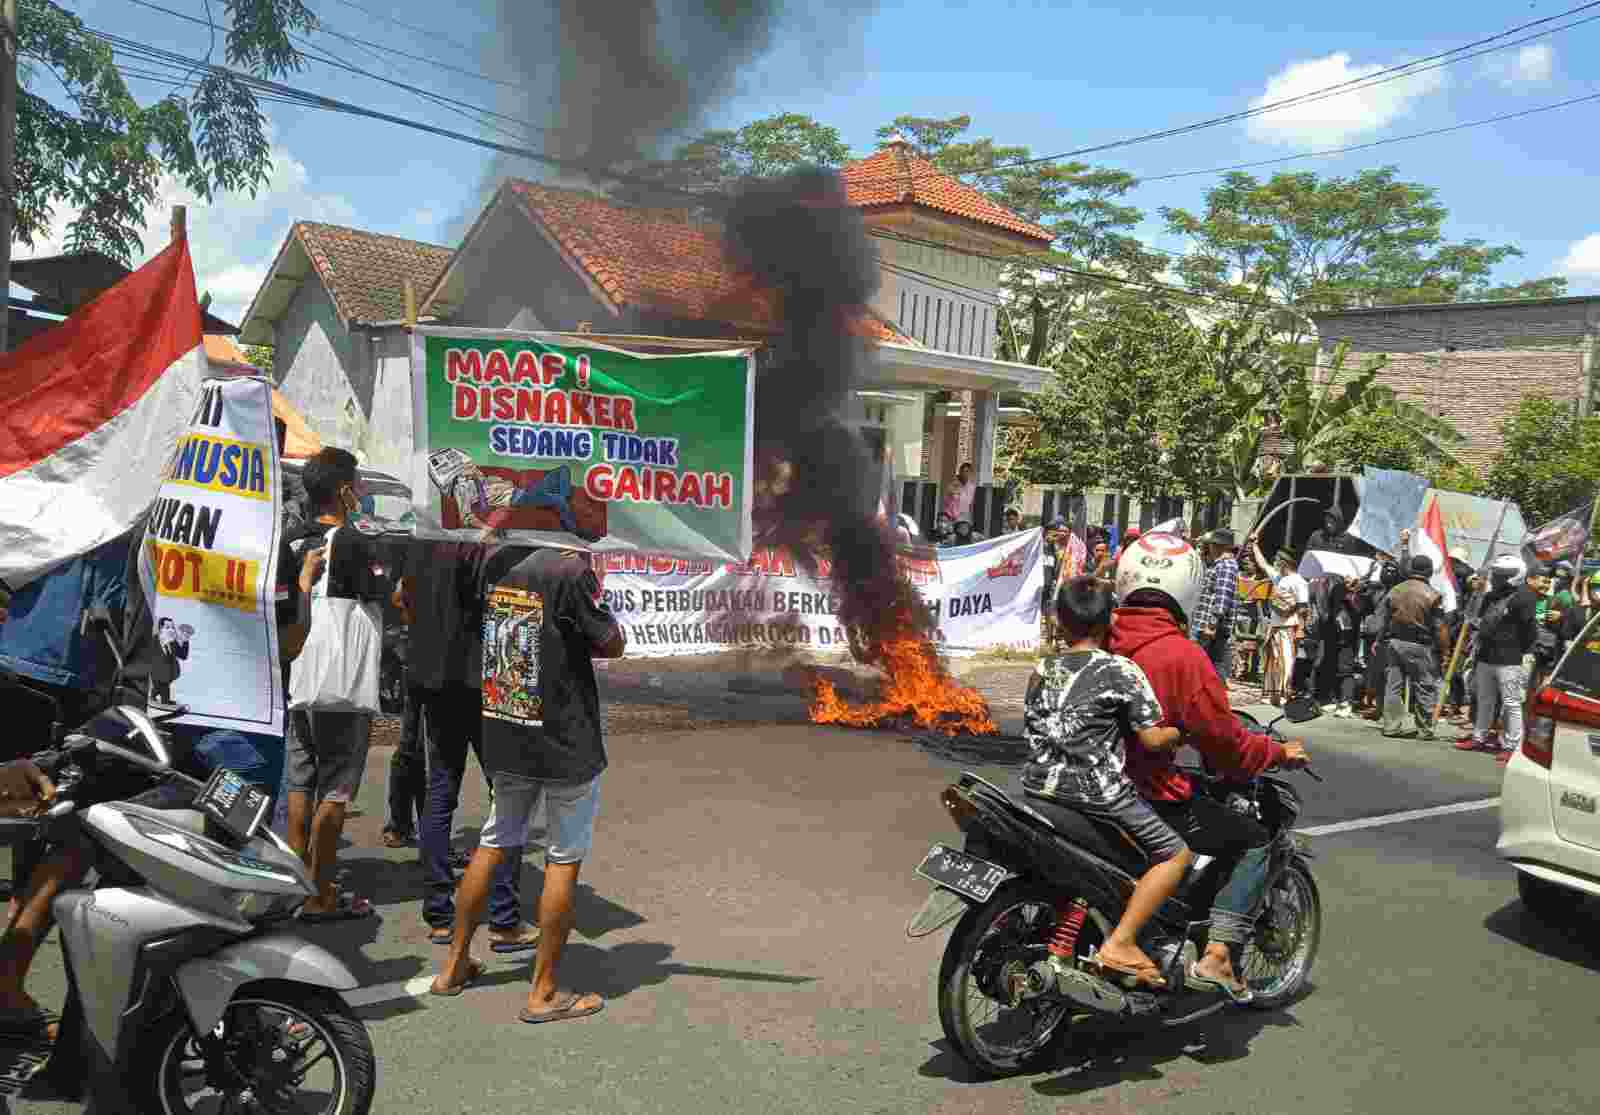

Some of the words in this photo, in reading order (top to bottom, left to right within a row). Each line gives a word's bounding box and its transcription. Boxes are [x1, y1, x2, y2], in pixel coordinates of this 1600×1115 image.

[446, 351, 564, 384] MAAF
[577, 355, 590, 387] !
[454, 386, 637, 431] DISNAKER
[491, 428, 591, 459] SEDANG
[603, 432, 679, 465] TIDAK
[586, 464, 731, 508] GAIRAH
[642, 590, 765, 612] PERBUDAKAN
[950, 592, 993, 617] DAYA
